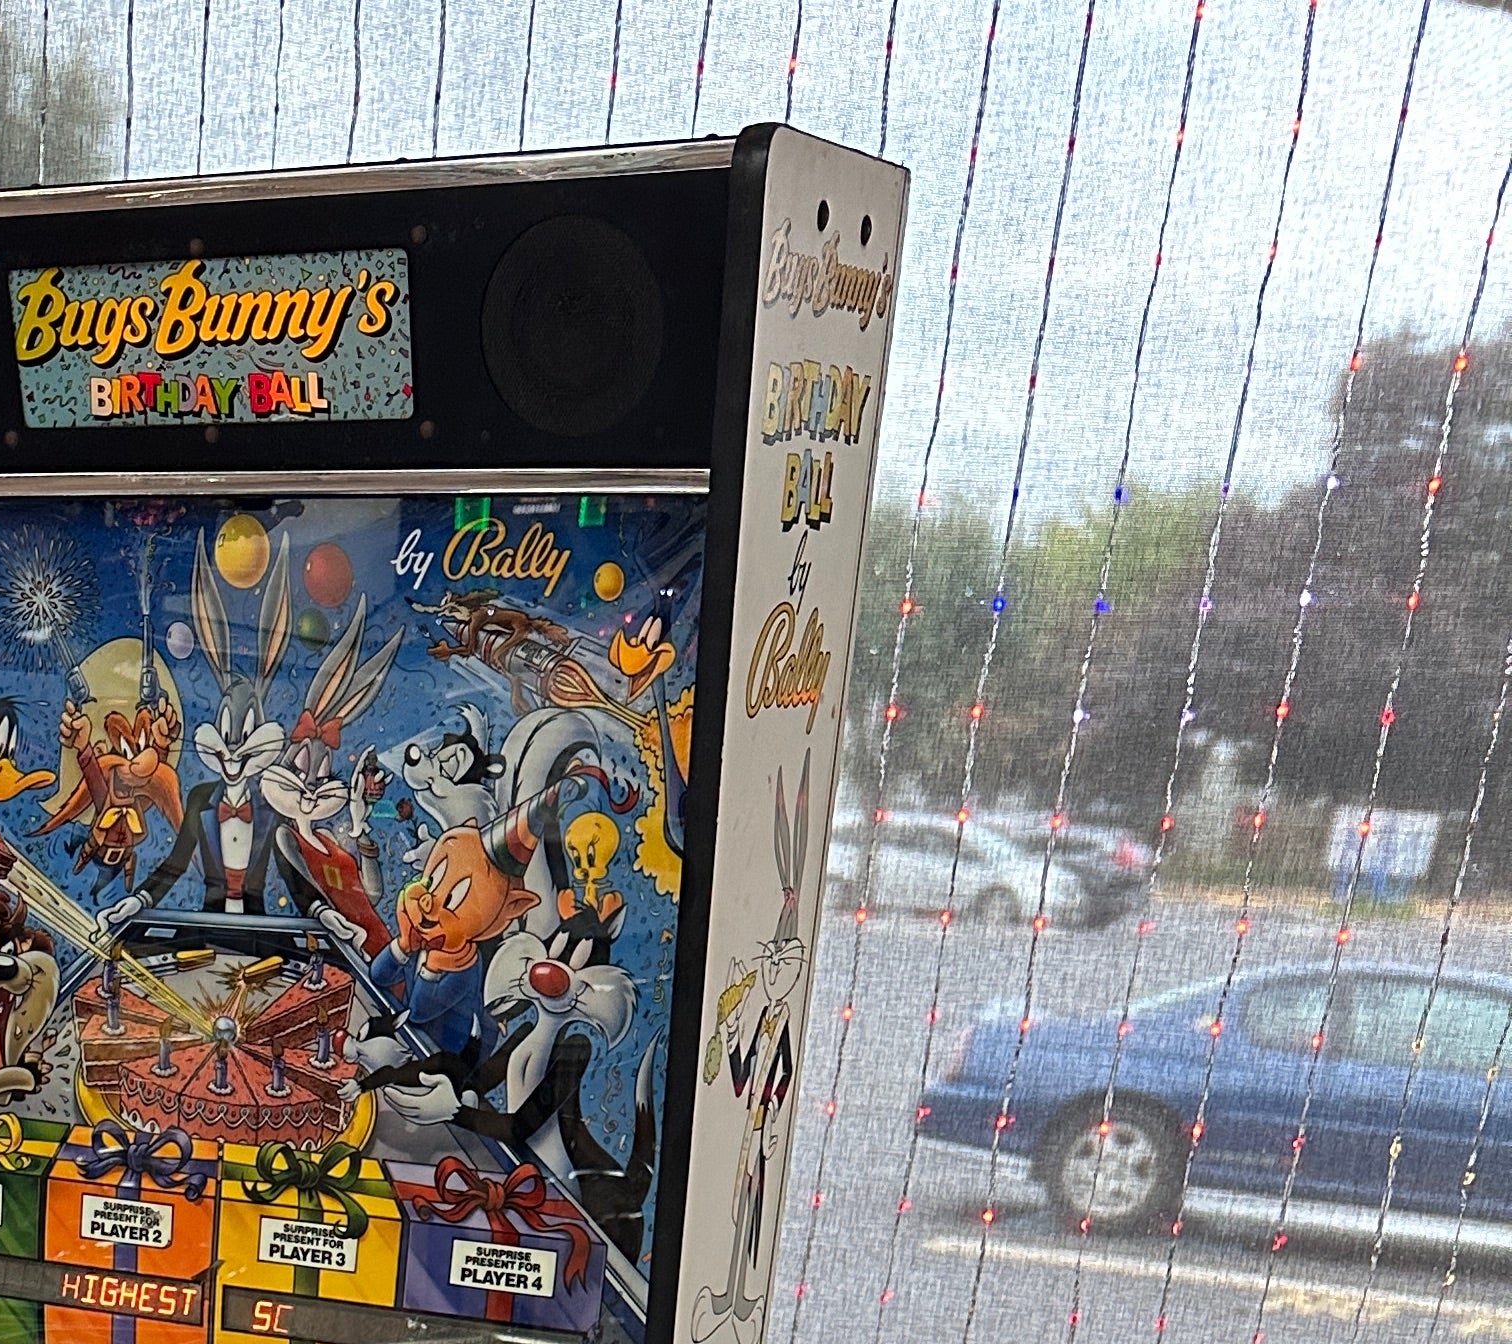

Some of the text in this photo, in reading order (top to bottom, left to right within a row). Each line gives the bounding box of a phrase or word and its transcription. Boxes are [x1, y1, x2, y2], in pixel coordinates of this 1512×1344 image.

[762, 217, 892, 332] Bugs Bunny's
[16, 259, 400, 364] Bugs Bunny's
[90, 371, 328, 417] BIRTHDAY BALL
[761, 359, 871, 446] BIRTHDAY
[781, 449, 834, 532] BALL
[390, 517, 572, 597] by Bally
[788, 529, 812, 616] by
[746, 601, 831, 734] Bally
[94, 1210, 160, 1228] PRESENT FOR
[103, 1201, 152, 1216] SURPRISE
[90, 1220, 162, 1243] PLAYER 2
[273, 1231, 344, 1250] PRESENT FOR
[283, 1223, 336, 1239] SURPRISE
[269, 1244, 346, 1266] PLAYER 3
[465, 1256, 541, 1273] PRESENT FOR
[476, 1246, 531, 1261] SURPRISE
[460, 1267, 543, 1291] PLAYER 4
[62, 1273, 294, 1333] HIGHEST SC
